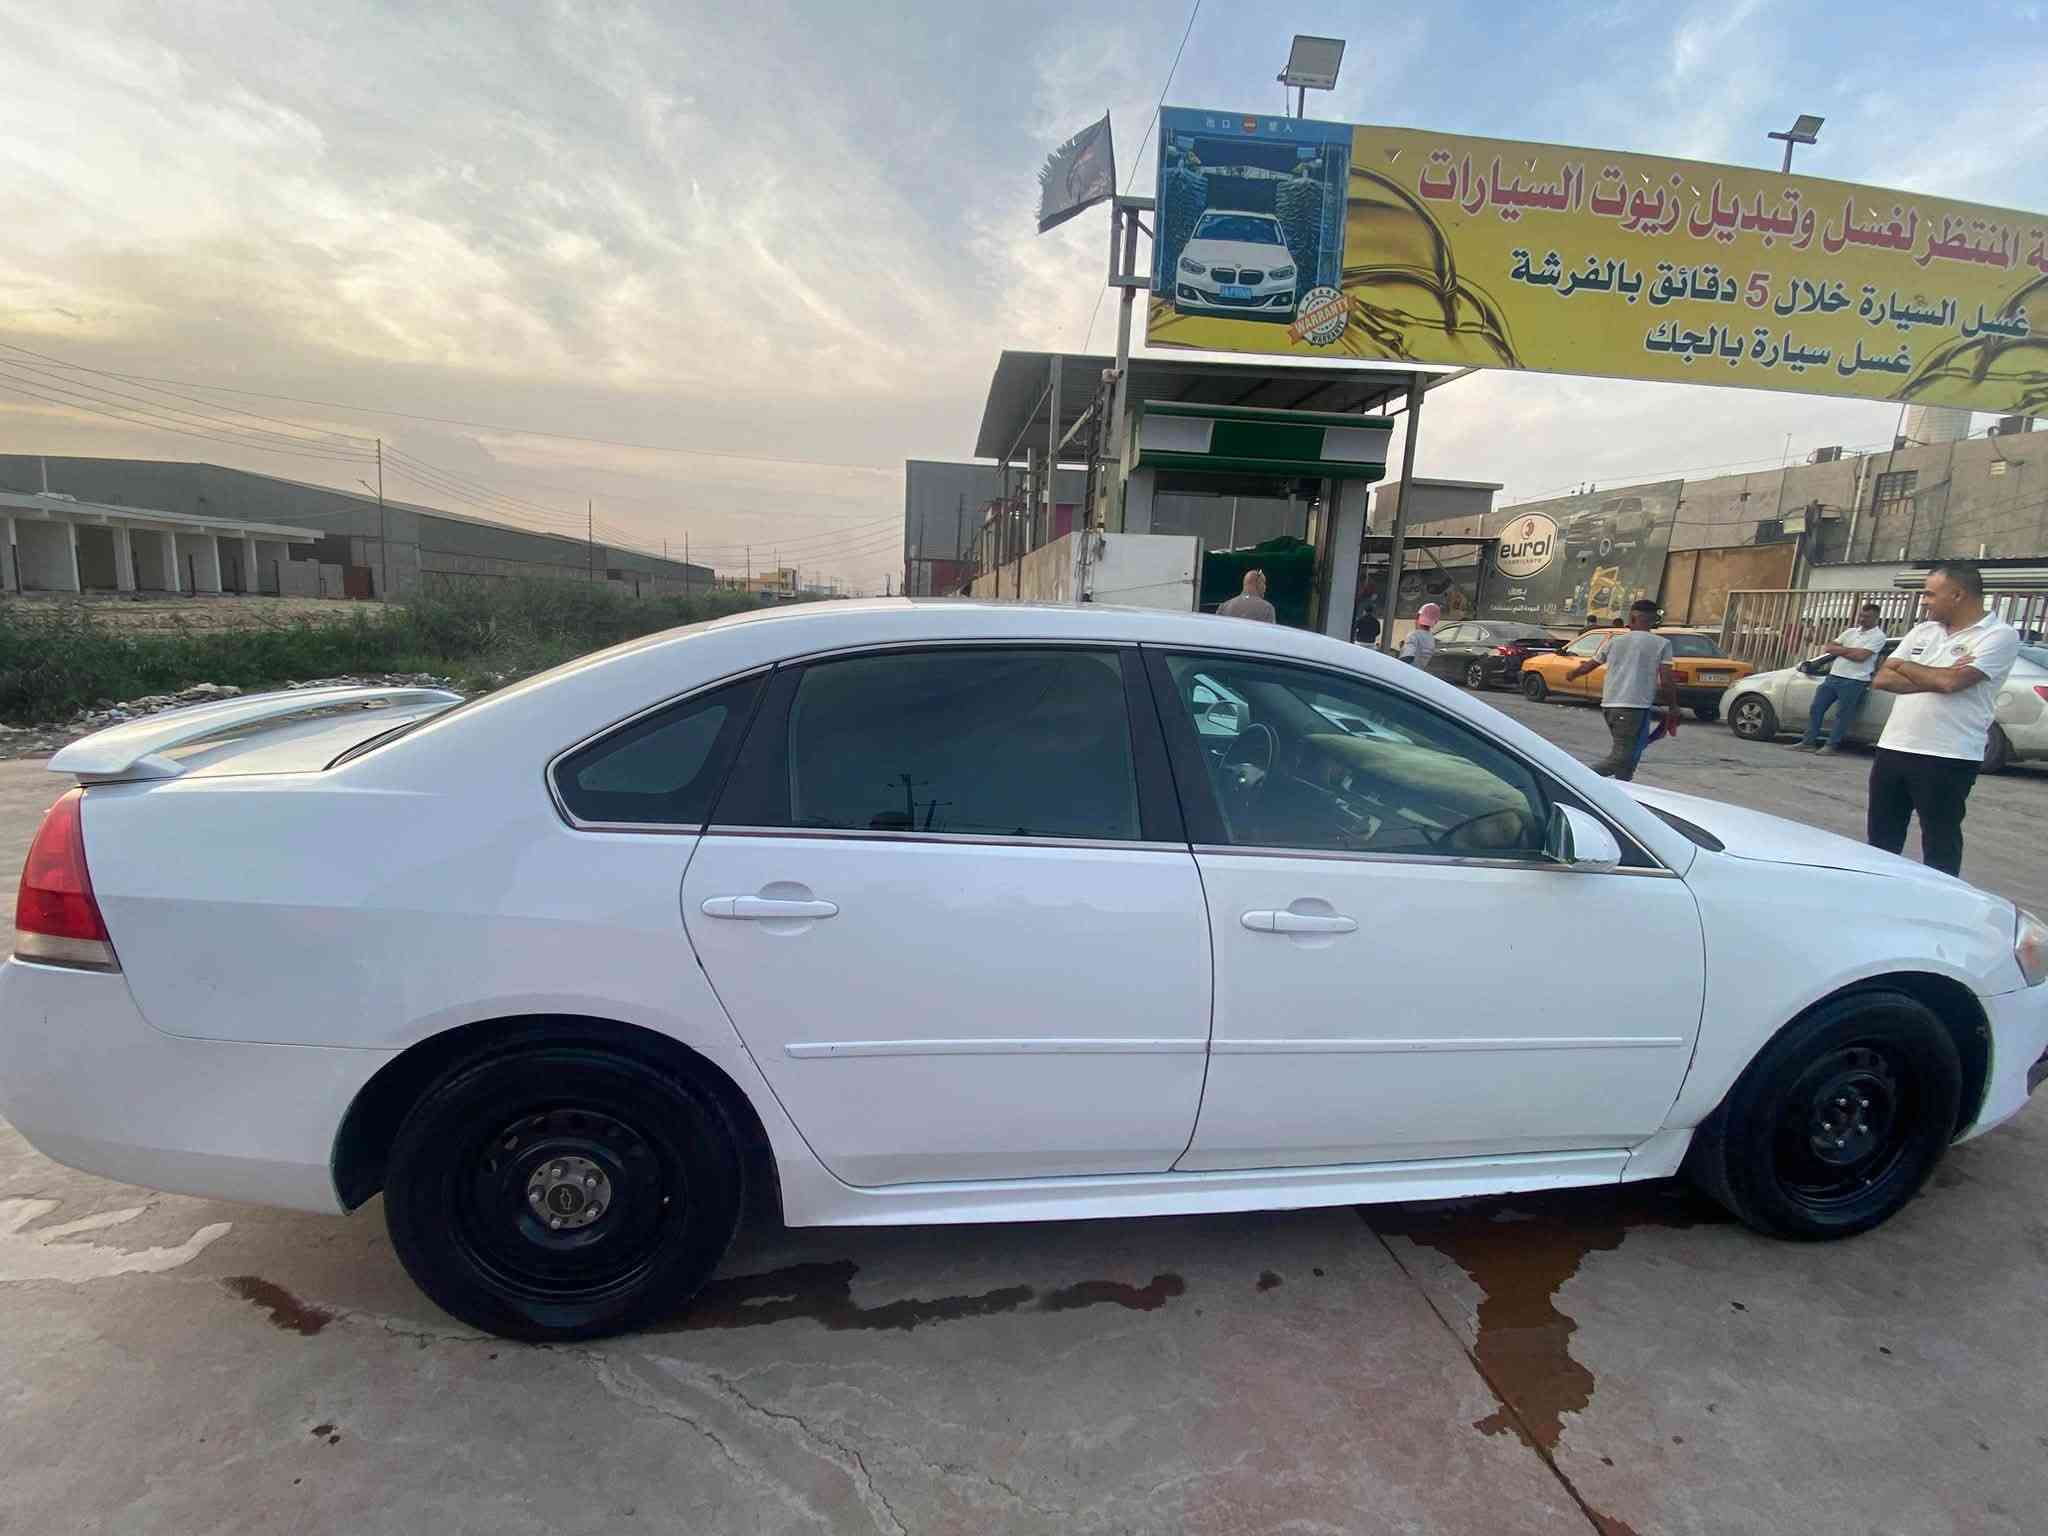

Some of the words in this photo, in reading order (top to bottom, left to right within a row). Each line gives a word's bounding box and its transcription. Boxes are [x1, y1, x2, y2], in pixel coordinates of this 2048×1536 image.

[1418, 148, 1584, 223] السيارات
[1588, 164, 1684, 234] زيوت
[1688, 178, 1816, 250] وتبديل
[1822, 197, 1918, 253] لغسل
[1914, 214, 2020, 270] المنتظر
[1510, 247, 1643, 304] بالفرشة
[1649, 262, 1738, 306] دقائق
[1743, 271, 1771, 308] 5
[1773, 277, 1851, 317] خلال
[1857, 283, 1956, 331] السيارة
[1960, 303, 2031, 338] غسل
[1644, 322, 1743, 366] بالجك
[1749, 328, 1832, 373] سيارة
[1837, 338, 1912, 377] غسل
[1500, 534, 1552, 558] eurol
